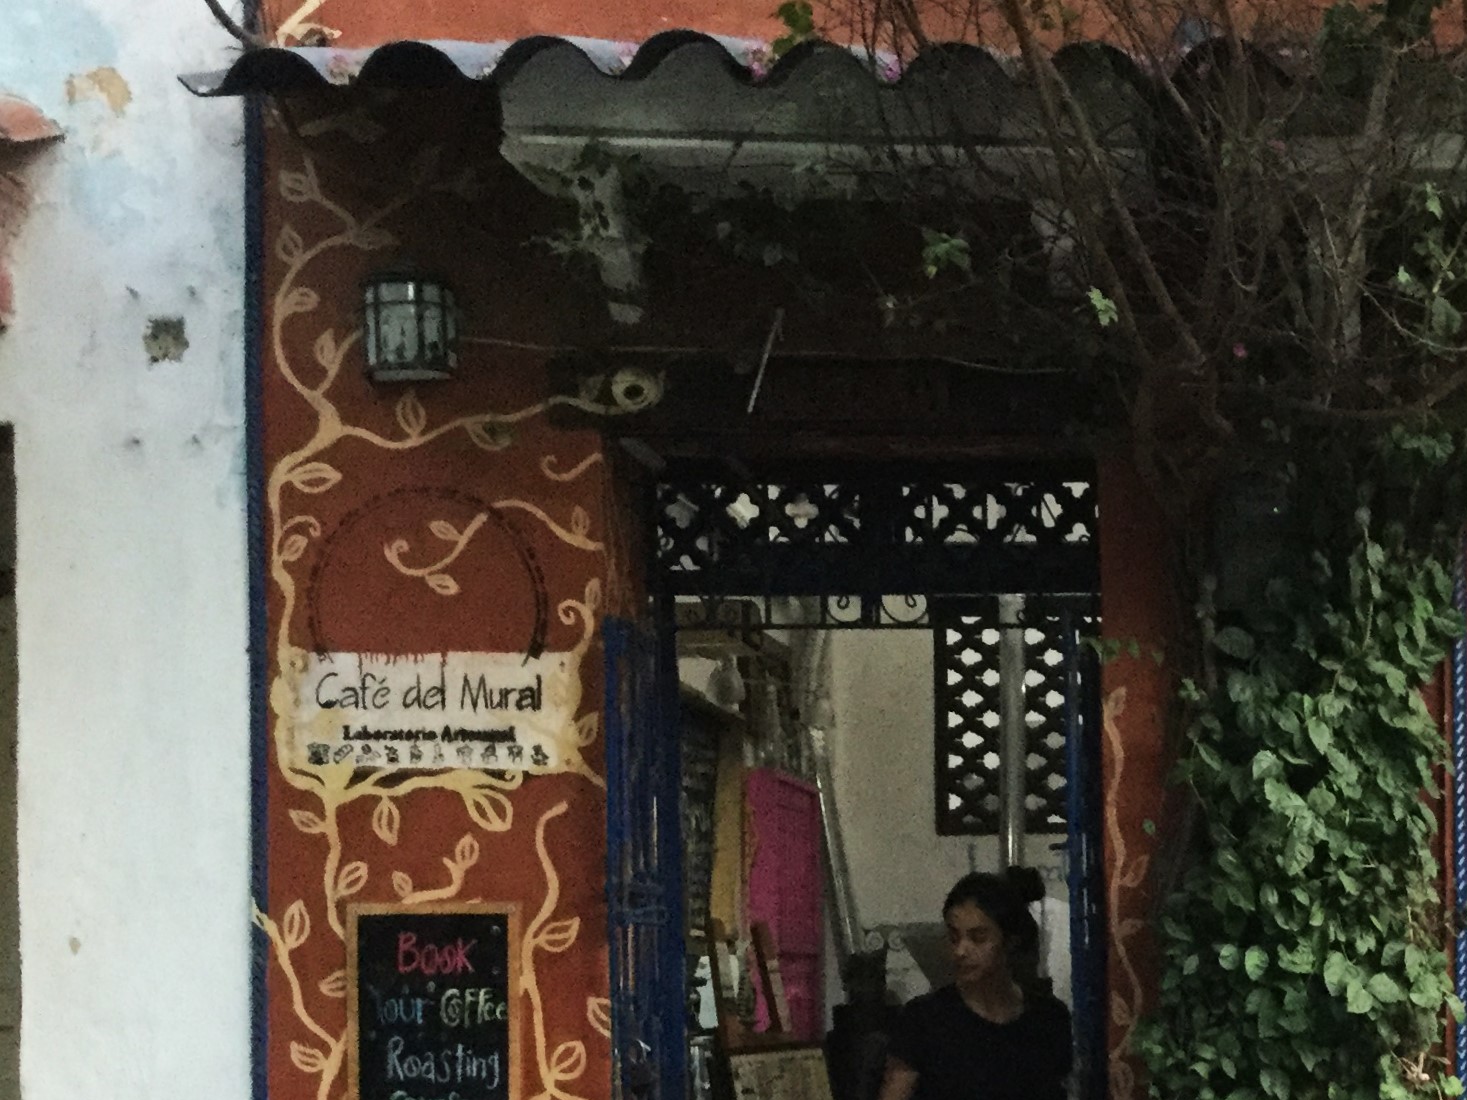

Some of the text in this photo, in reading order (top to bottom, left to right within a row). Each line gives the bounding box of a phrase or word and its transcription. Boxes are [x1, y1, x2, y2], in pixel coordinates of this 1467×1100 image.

[315, 671, 543, 713] Café del Mural
[386, 1035, 501, 1090] Roasting
